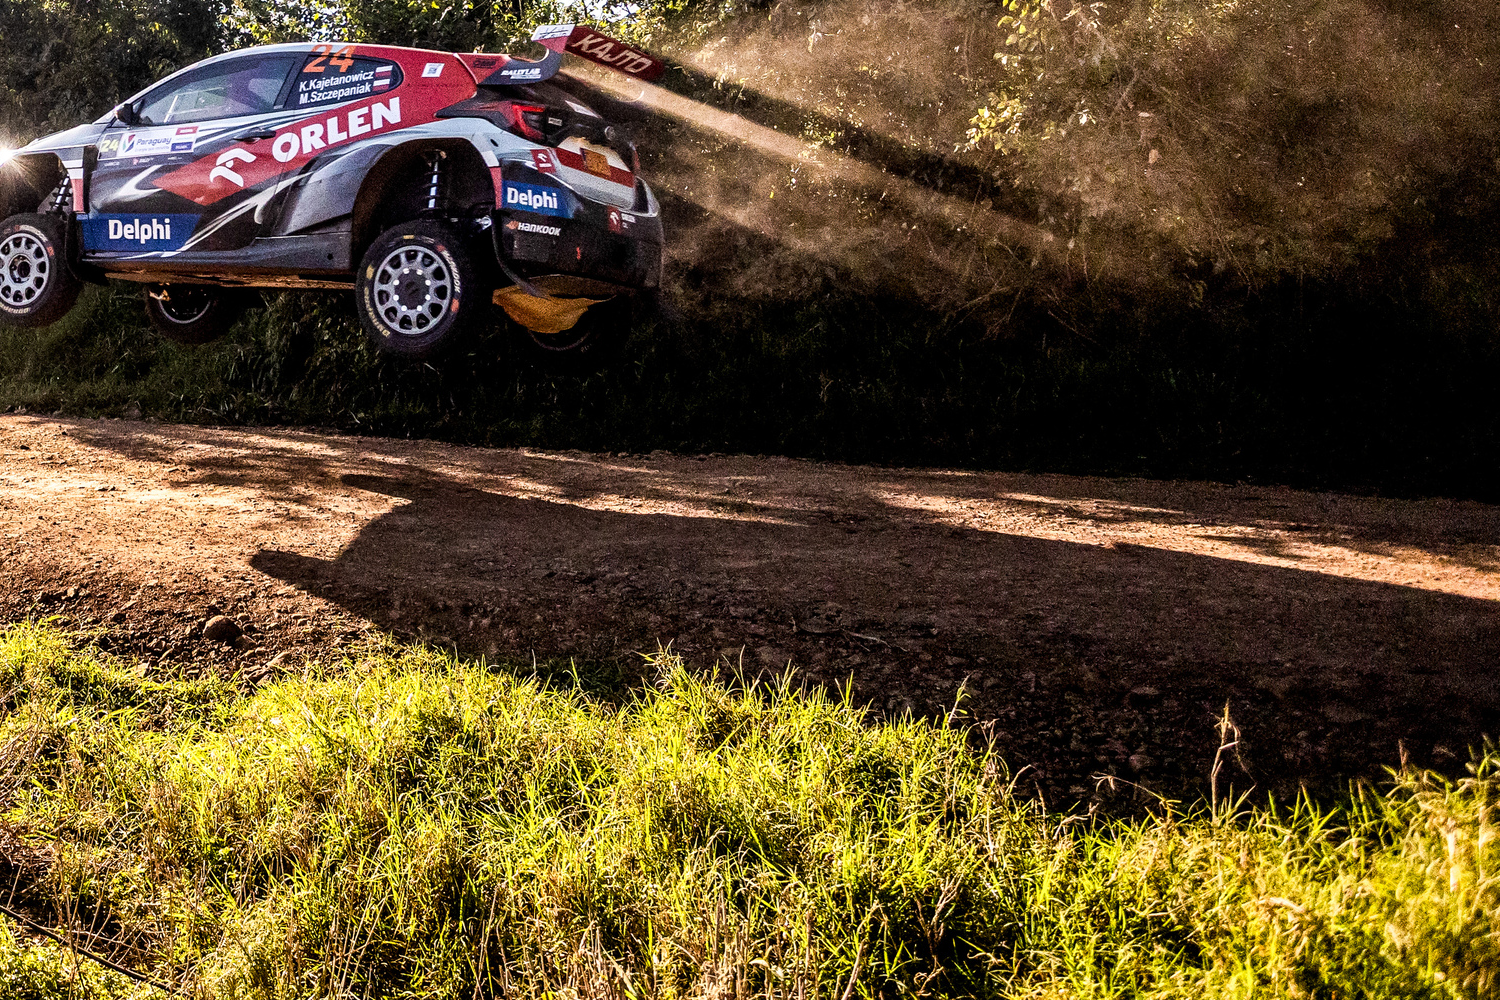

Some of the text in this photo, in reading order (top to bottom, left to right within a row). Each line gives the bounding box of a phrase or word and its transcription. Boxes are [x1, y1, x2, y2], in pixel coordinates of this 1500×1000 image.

[303, 44, 356, 72] 24
[299, 71, 374, 92] K.Kajetanowicz
[299, 82, 372, 104] M.Szczepaniak
[272, 96, 401, 163] ORLEN
[101, 139, 119, 152] 24
[136, 137, 172, 146] Paraguay
[507, 187, 558, 210] Delphi
[108, 218, 171, 244] Delphi
